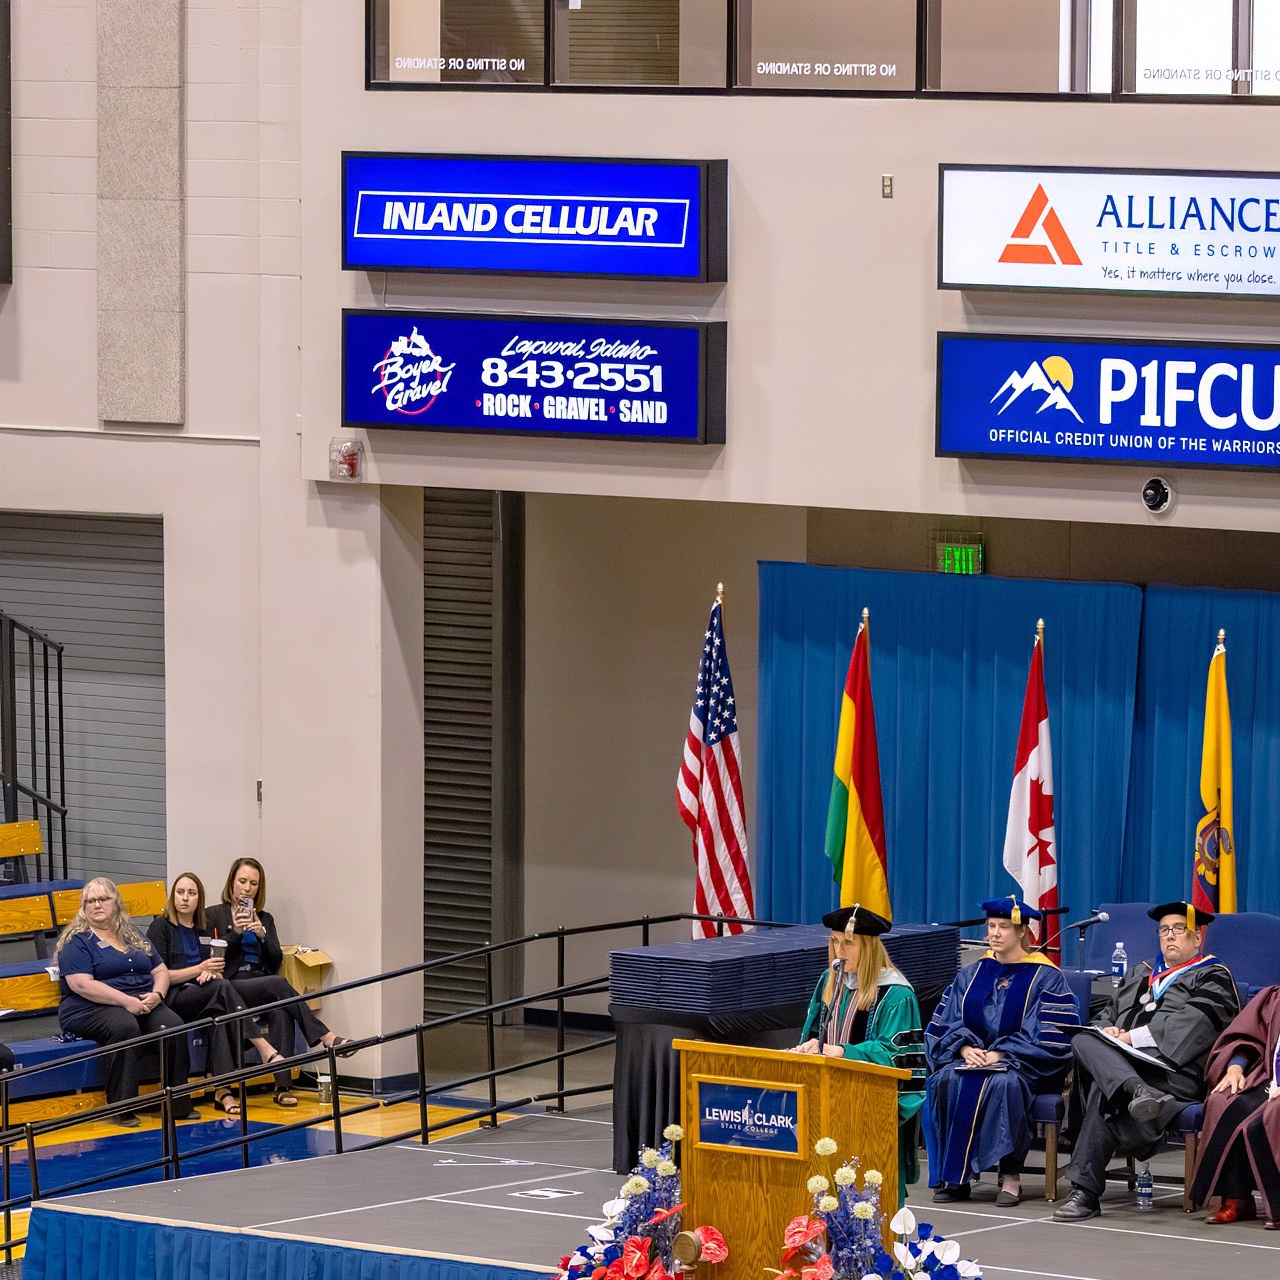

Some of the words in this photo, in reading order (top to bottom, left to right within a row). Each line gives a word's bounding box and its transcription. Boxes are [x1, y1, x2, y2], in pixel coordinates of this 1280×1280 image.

[383, 201, 497, 232] INLAND
[504, 204, 658, 237] CELLULAR
[1101, 241, 1156, 255] TITLE
[1170, 243, 1179, 255] &
[1194, 244, 1277, 258] ESCROW
[1101, 266, 1122, 280] Yes,
[1127, 266, 1136, 279] it
[1140, 267, 1182, 282] matters
[1187, 269, 1219, 283] where
[1224, 273, 1243, 289] you
[1247, 271, 1276, 285] close.
[501, 335, 584, 360] Lapwai,
[585, 338, 658, 360] Idaho
[372, 355, 456, 393] Boyer
[386, 371, 452, 411] Gravel
[483, 394, 531, 418] ROCK
[543, 397, 607, 422] GRAVEL
[619, 400, 667, 424] SAND
[990, 429, 1051, 444] OFFICIAL
[1055, 432, 1105, 447] CREDIT
[1110, 434, 1153, 449] UNION
[1158, 437, 1176, 450] OF
[1179, 437, 1207, 451] THE
[705, 1107, 741, 1122] LEWIS
[754, 1112, 793, 1129] CLARK
[721, 1122, 741, 1130] STATE
[745, 1125, 778, 1134] COLLEGE
